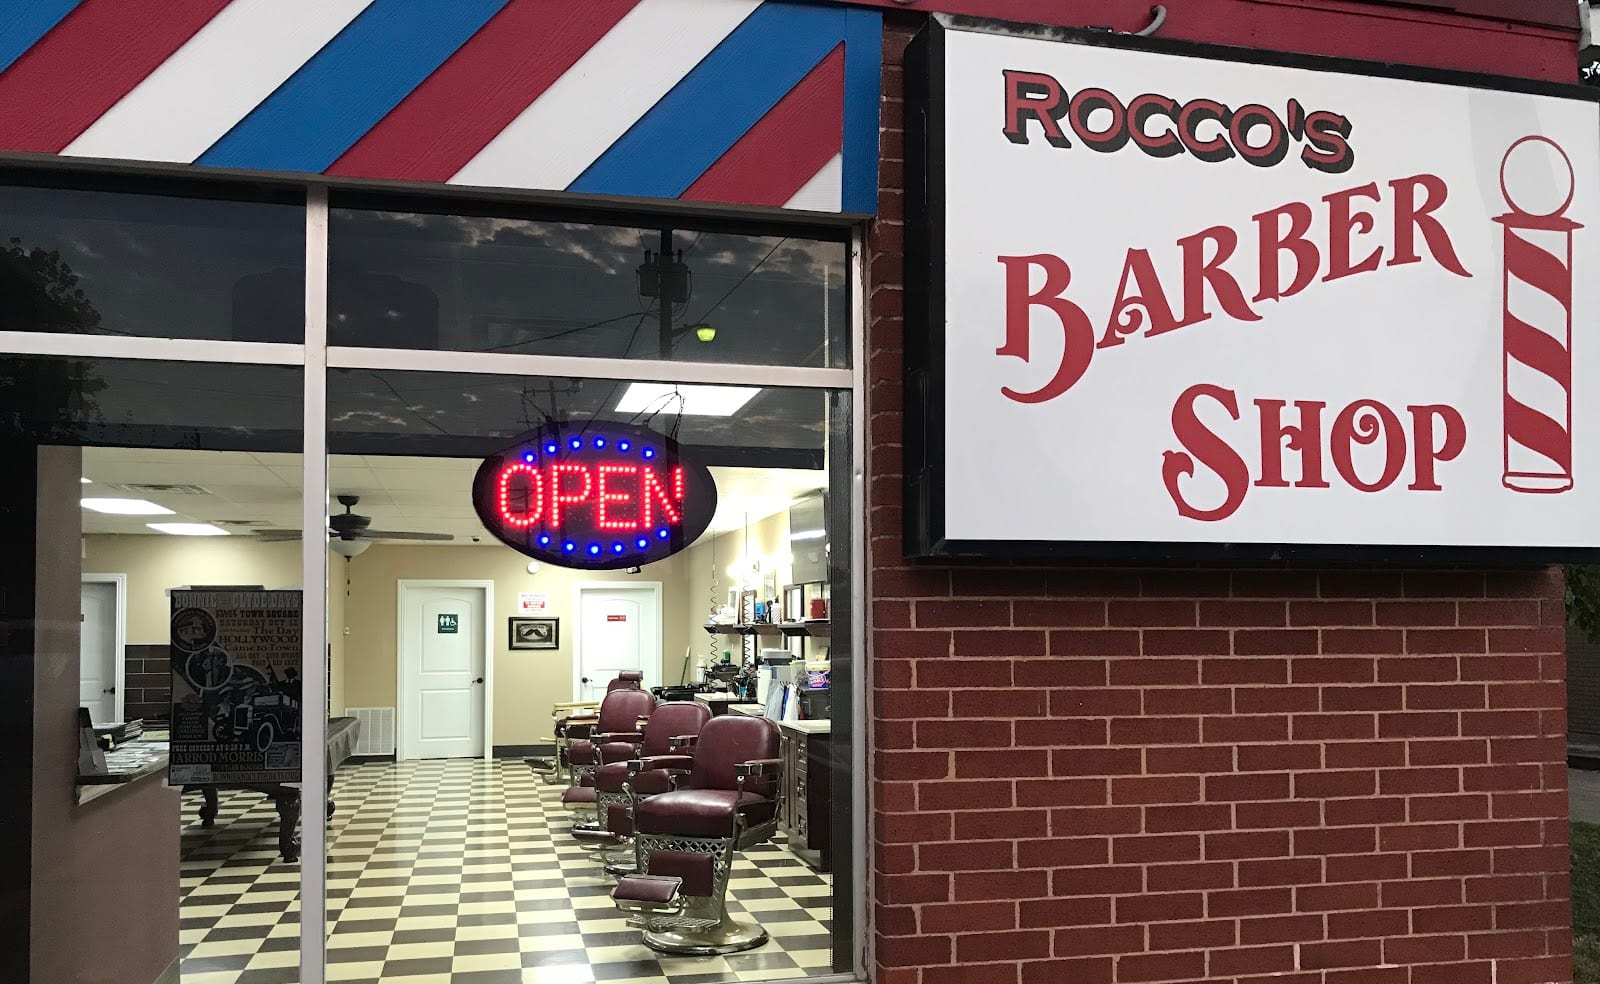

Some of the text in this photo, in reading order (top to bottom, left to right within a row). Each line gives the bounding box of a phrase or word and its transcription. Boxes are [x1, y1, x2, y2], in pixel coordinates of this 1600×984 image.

[1002, 69, 1354, 173] ROCCO'S
[996, 174, 1473, 404] BARBER
[498, 461, 684, 530] OPEN
[1162, 383, 1467, 522] SHOP
[218, 635, 299, 643] HOLLYWOOD
[218, 751, 265, 762] MORRIS
